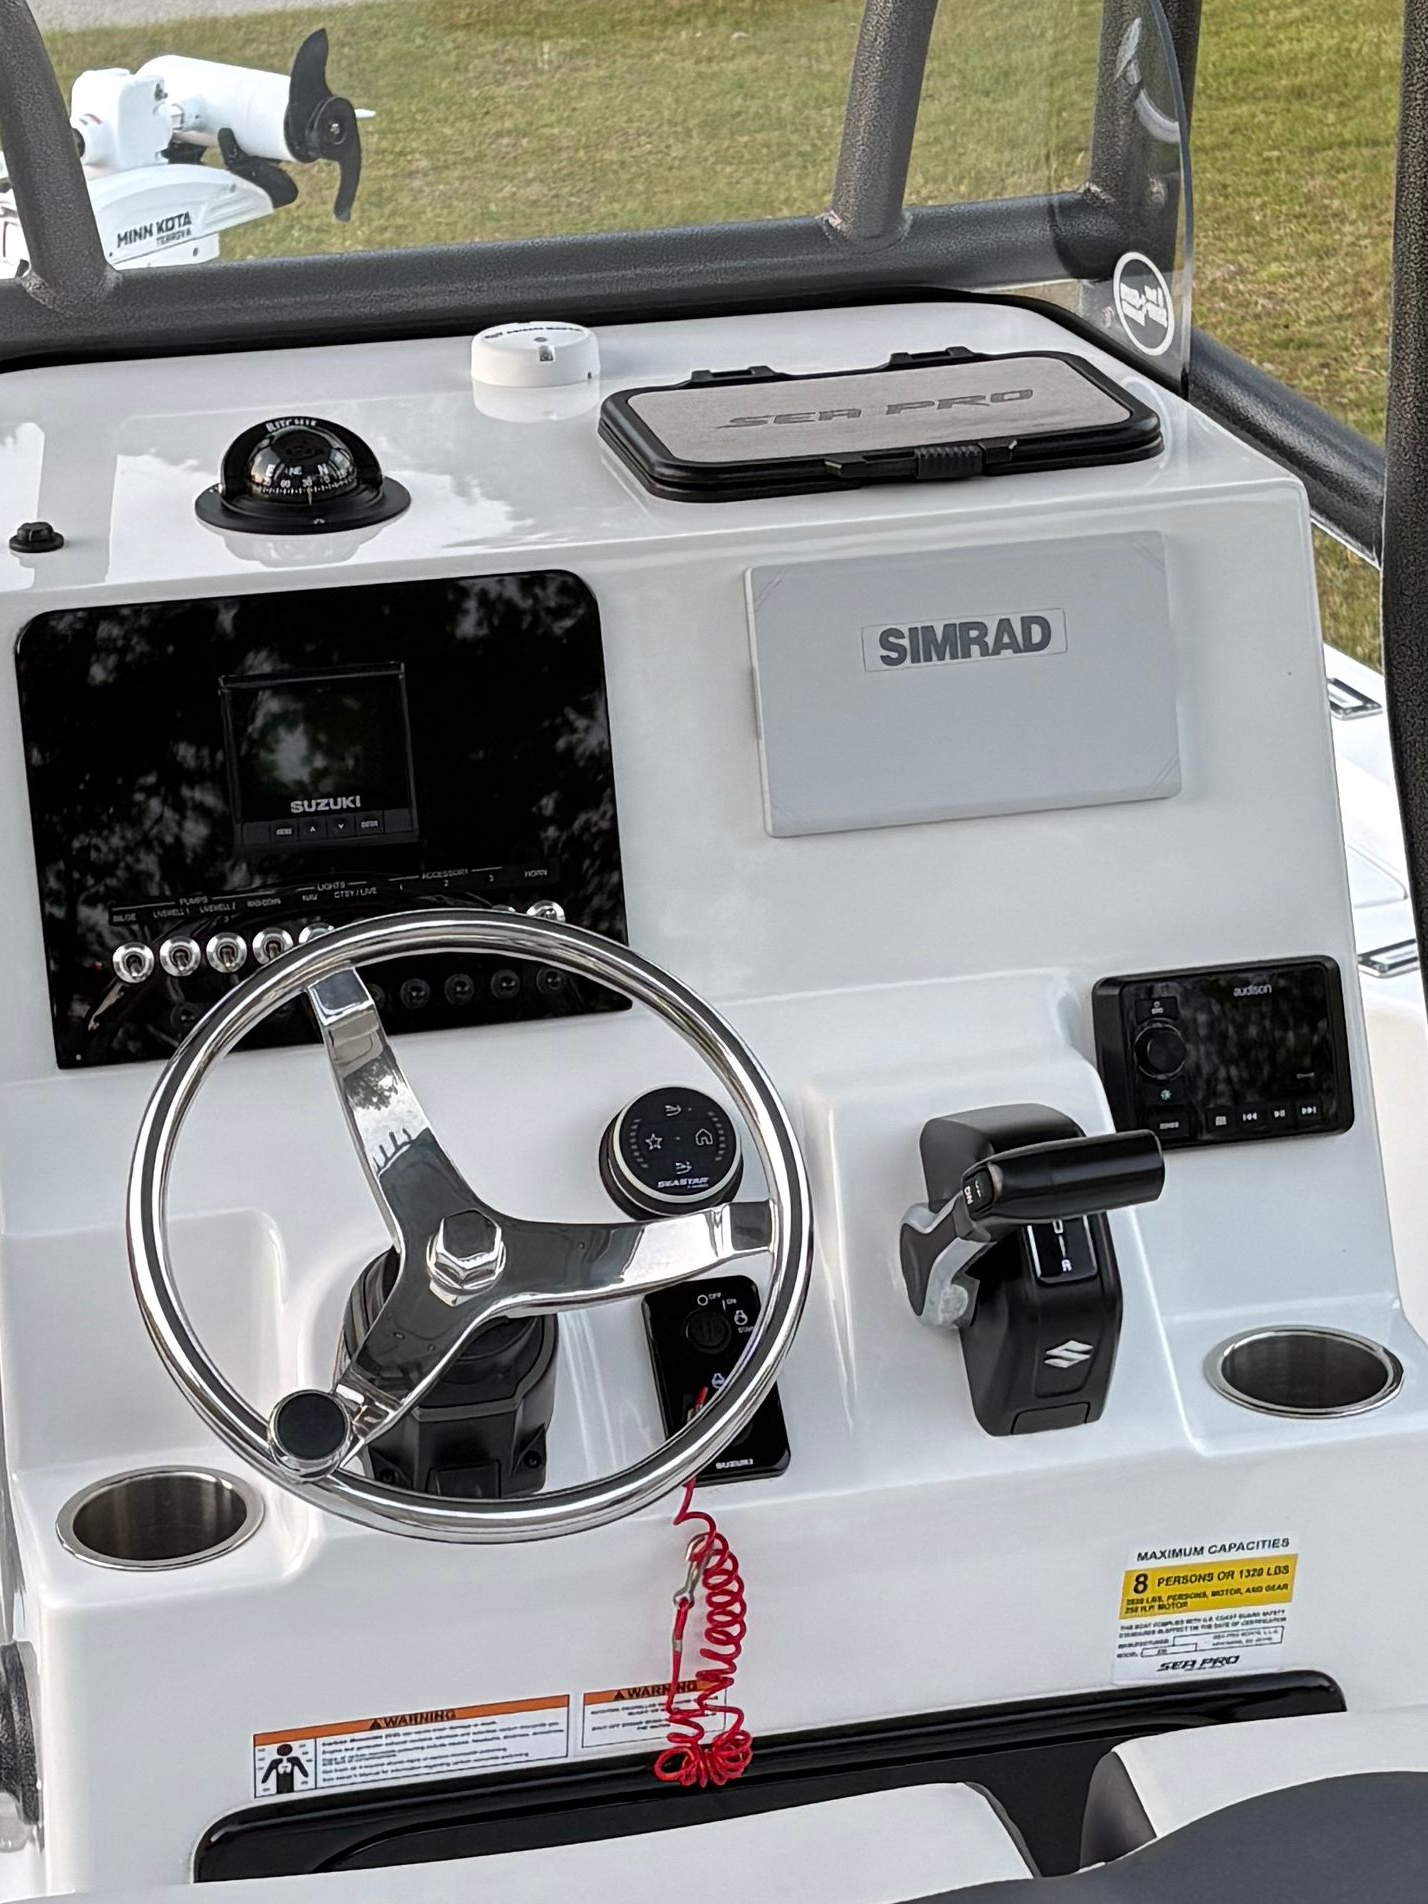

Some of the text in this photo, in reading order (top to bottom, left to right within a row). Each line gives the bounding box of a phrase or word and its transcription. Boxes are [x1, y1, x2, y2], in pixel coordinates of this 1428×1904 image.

[117, 211, 192, 248] MINN KOTA
[716, 389, 1033, 429] SEA PRO
[878, 615, 1052, 668] SIMRAD
[290, 795, 362, 814] SUZUKI
[1233, 983, 1273, 997] audison
[1061, 1259, 1072, 1272] R
[1136, 1537, 1290, 1562] MAXIMUM CAPACITIES
[1133, 1573, 1148, 1594] 8
[1157, 1572, 1214, 1587] PERSONS
[1217, 1570, 1235, 1582] OR
[1266, 1565, 1290, 1576] LBS
[1155, 1654, 1241, 1673] SEA PRO
[626, 1681, 698, 1697] WARNNG
[383, 1709, 457, 1727] WARNING
